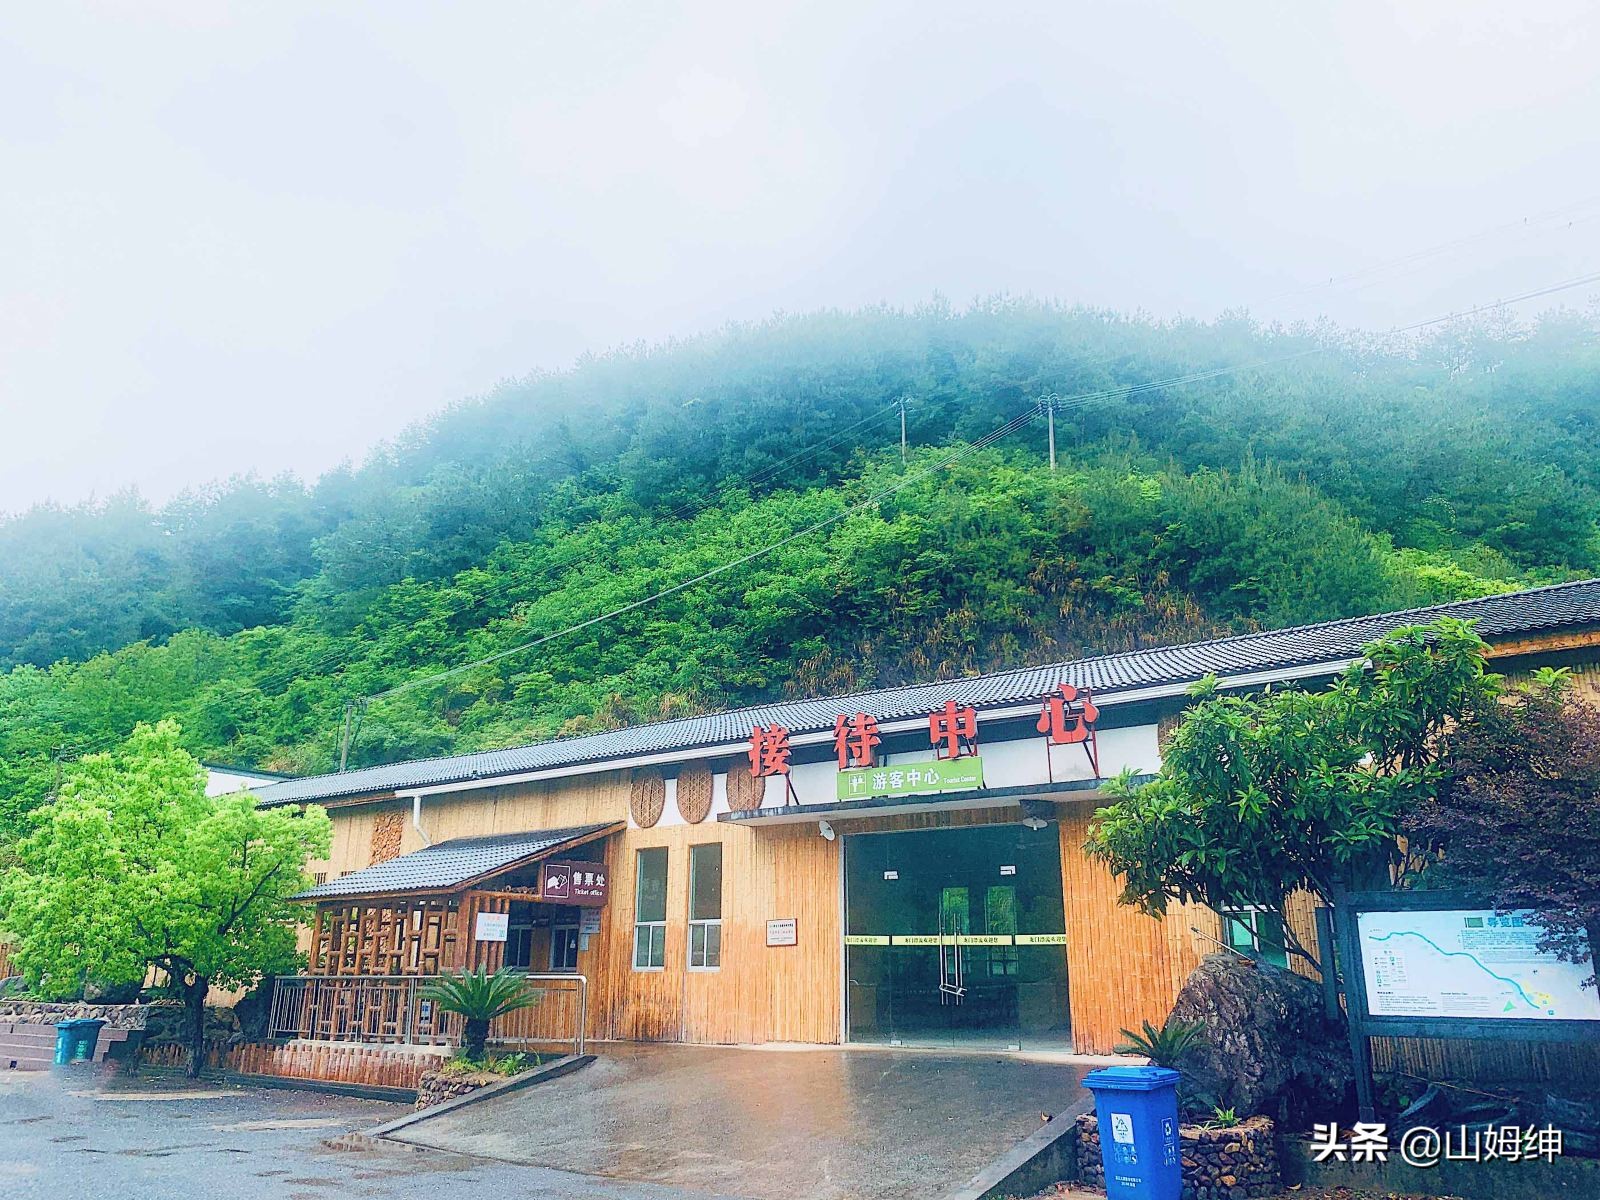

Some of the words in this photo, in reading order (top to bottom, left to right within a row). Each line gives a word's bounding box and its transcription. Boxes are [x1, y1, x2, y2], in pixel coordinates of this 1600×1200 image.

[748, 684, 1099, 778] 接待中心
[872, 767, 940, 790] 游客中心
[572, 871, 606, 887] 售票处
[574, 888, 589, 896] Ticket
